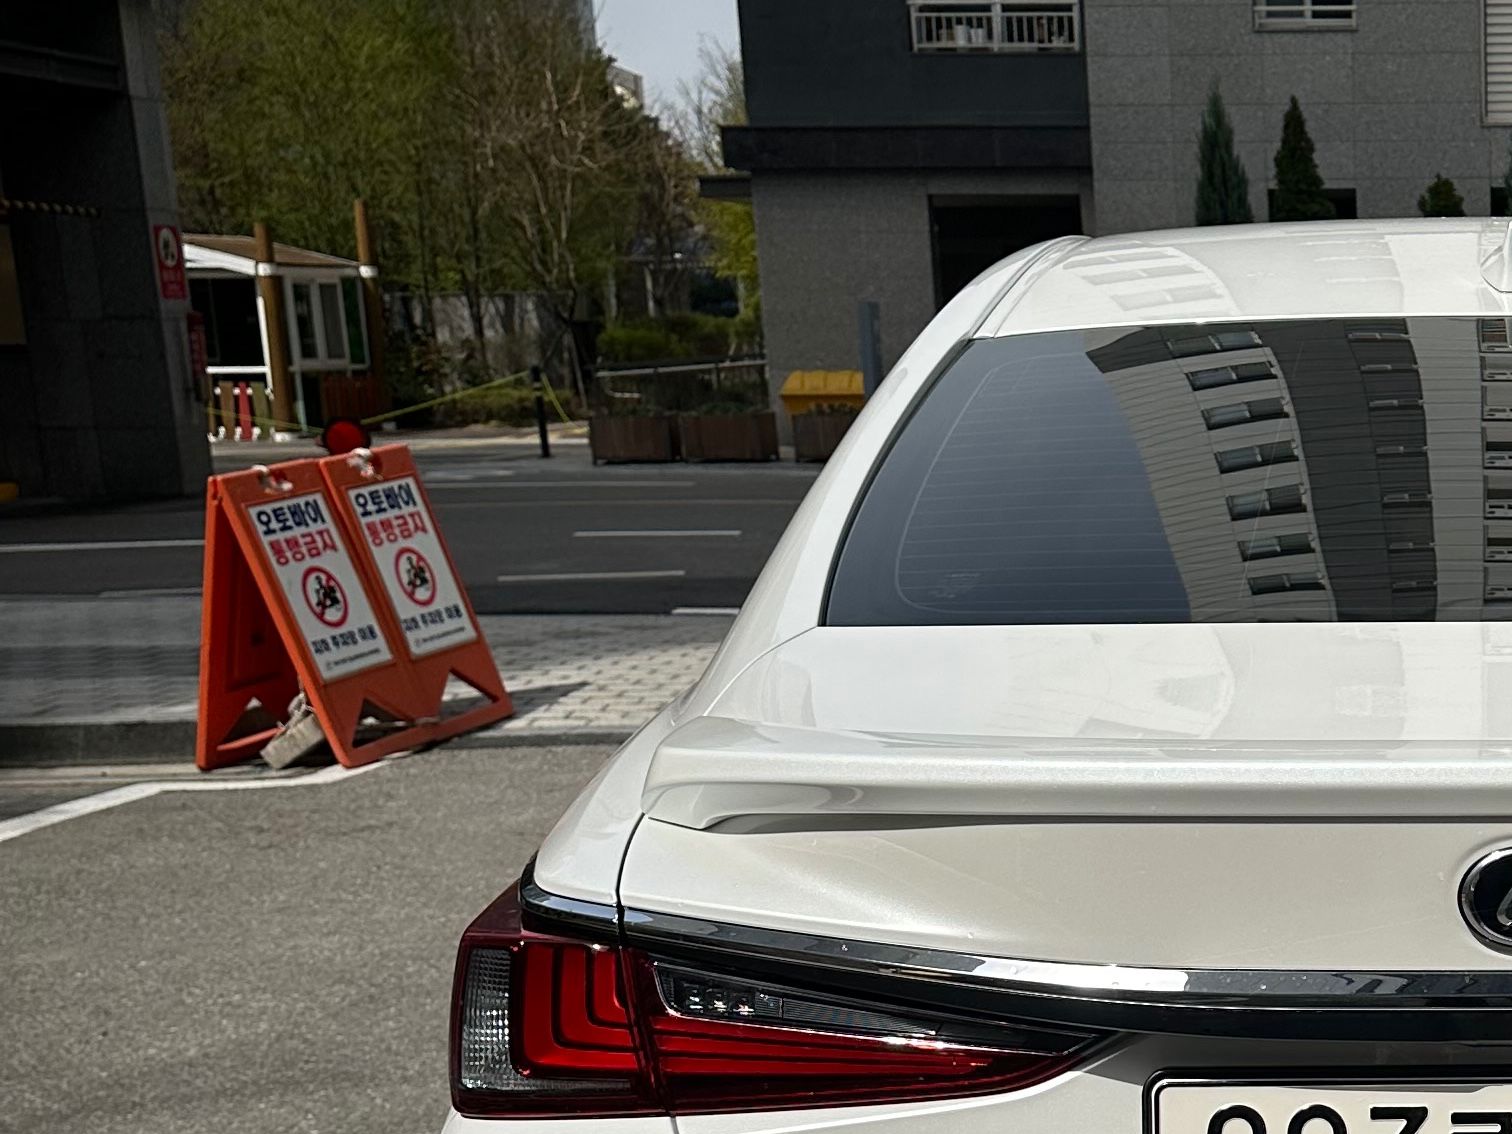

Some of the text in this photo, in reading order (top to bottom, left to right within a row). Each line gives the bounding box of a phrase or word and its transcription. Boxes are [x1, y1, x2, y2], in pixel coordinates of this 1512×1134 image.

[256, 499, 327, 536] 오토바이
[354, 482, 418, 518] 오토바이
[365, 510, 428, 547] 통행금지
[268, 528, 338, 567] 통행금지
